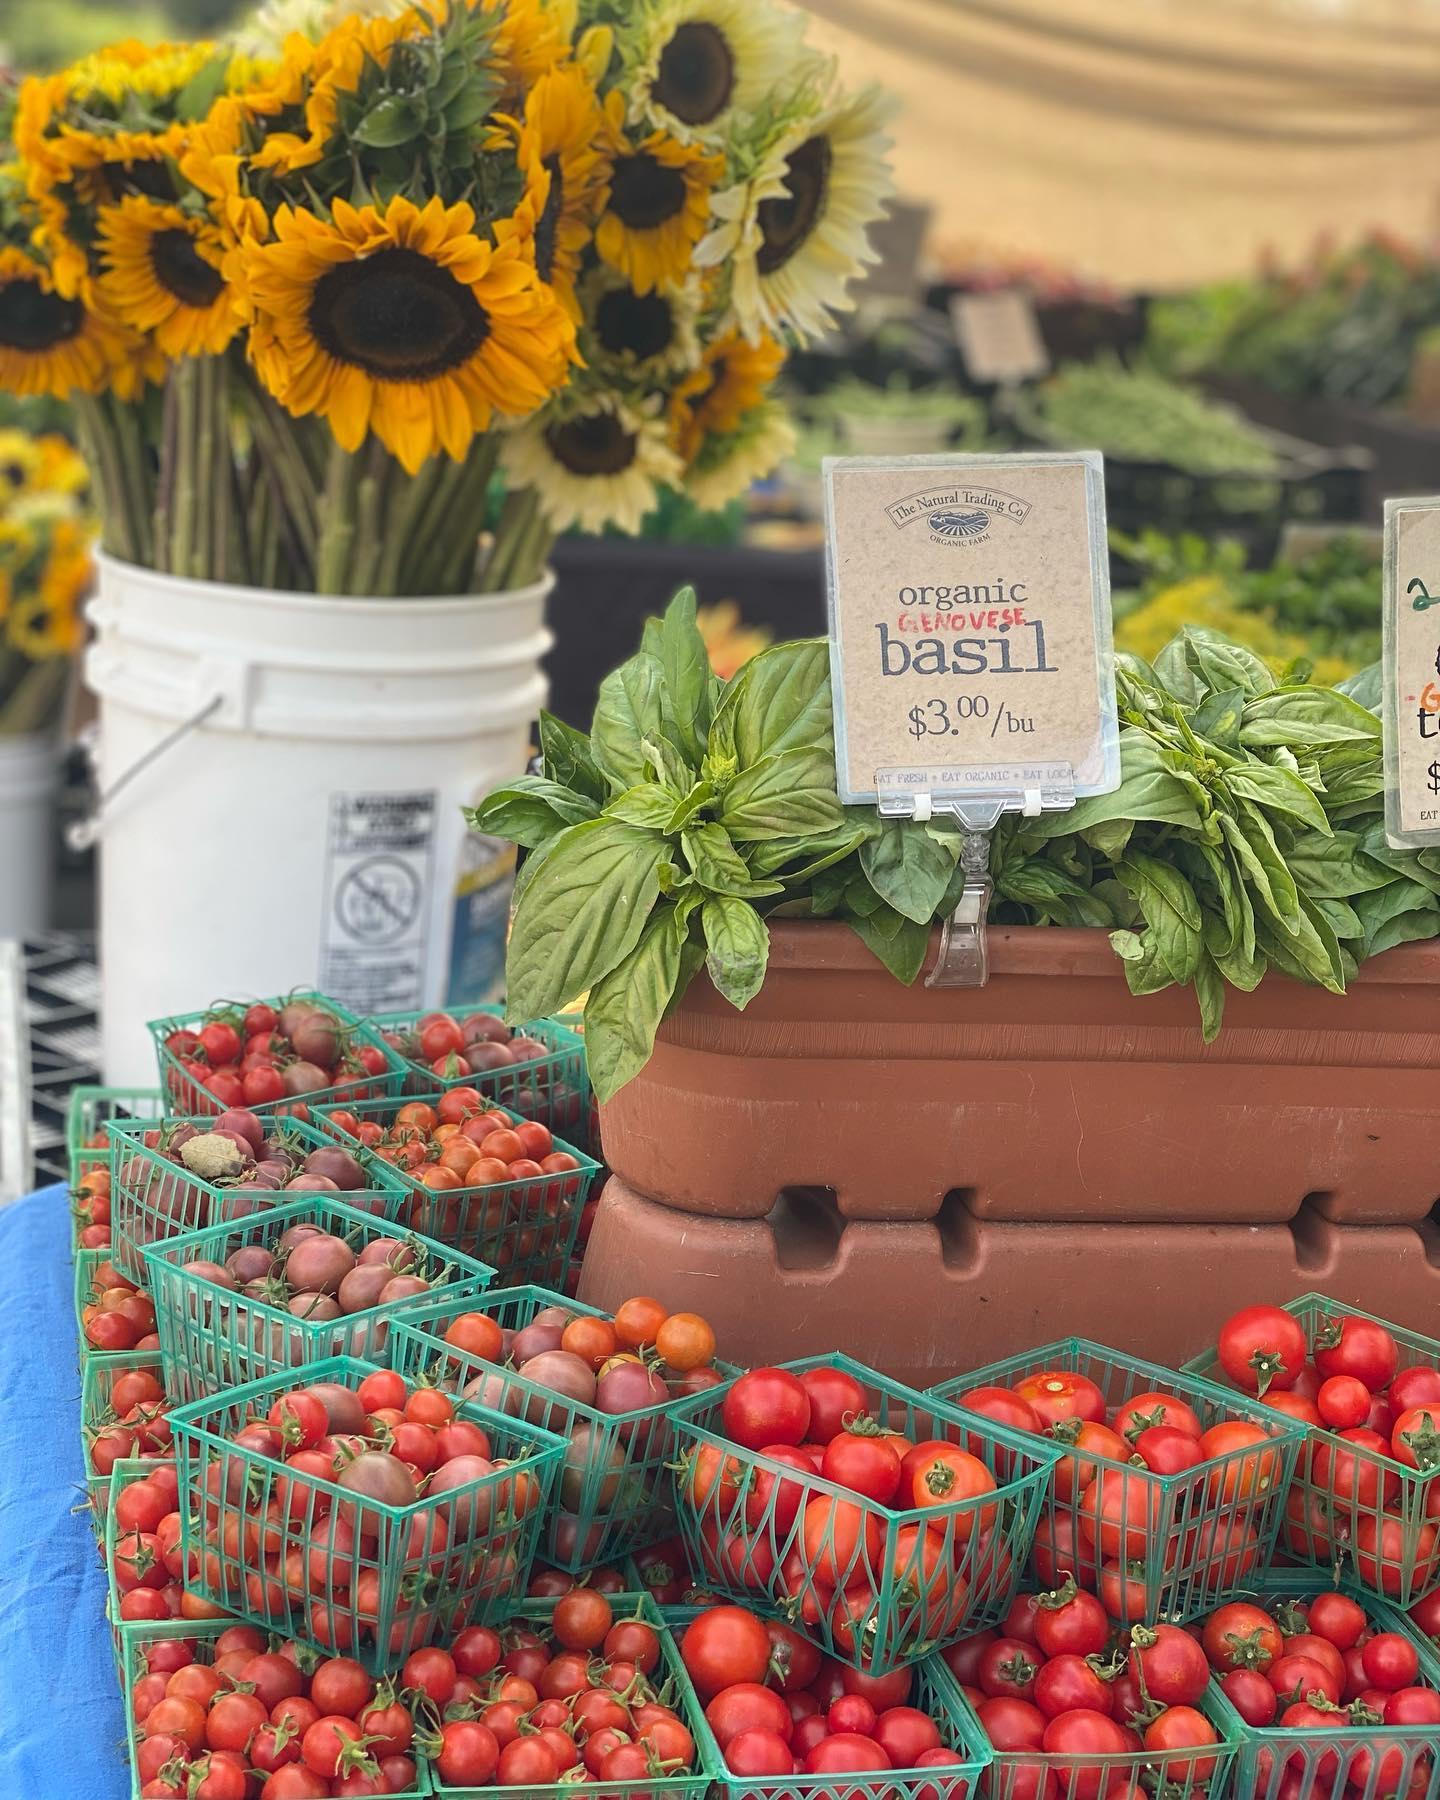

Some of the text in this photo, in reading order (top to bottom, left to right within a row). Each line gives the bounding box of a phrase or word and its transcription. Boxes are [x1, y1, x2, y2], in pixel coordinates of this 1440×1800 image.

[893, 490, 1024, 519] The Natural Trading Co
[929, 533, 991, 547] ORGANIC FARM
[899, 577, 1029, 611] organic
[898, 607, 1027, 633] GENOVESE
[875, 620, 1059, 676] basil
[873, 773, 892, 784] EAT
[897, 772, 928, 784] FRESH
[942, 771, 961, 782] EAT
[964, 770, 1009, 781] ORGANIC
[1023, 769, 1042, 780] EAT
[1420, 810, 1438, 820] EAT
